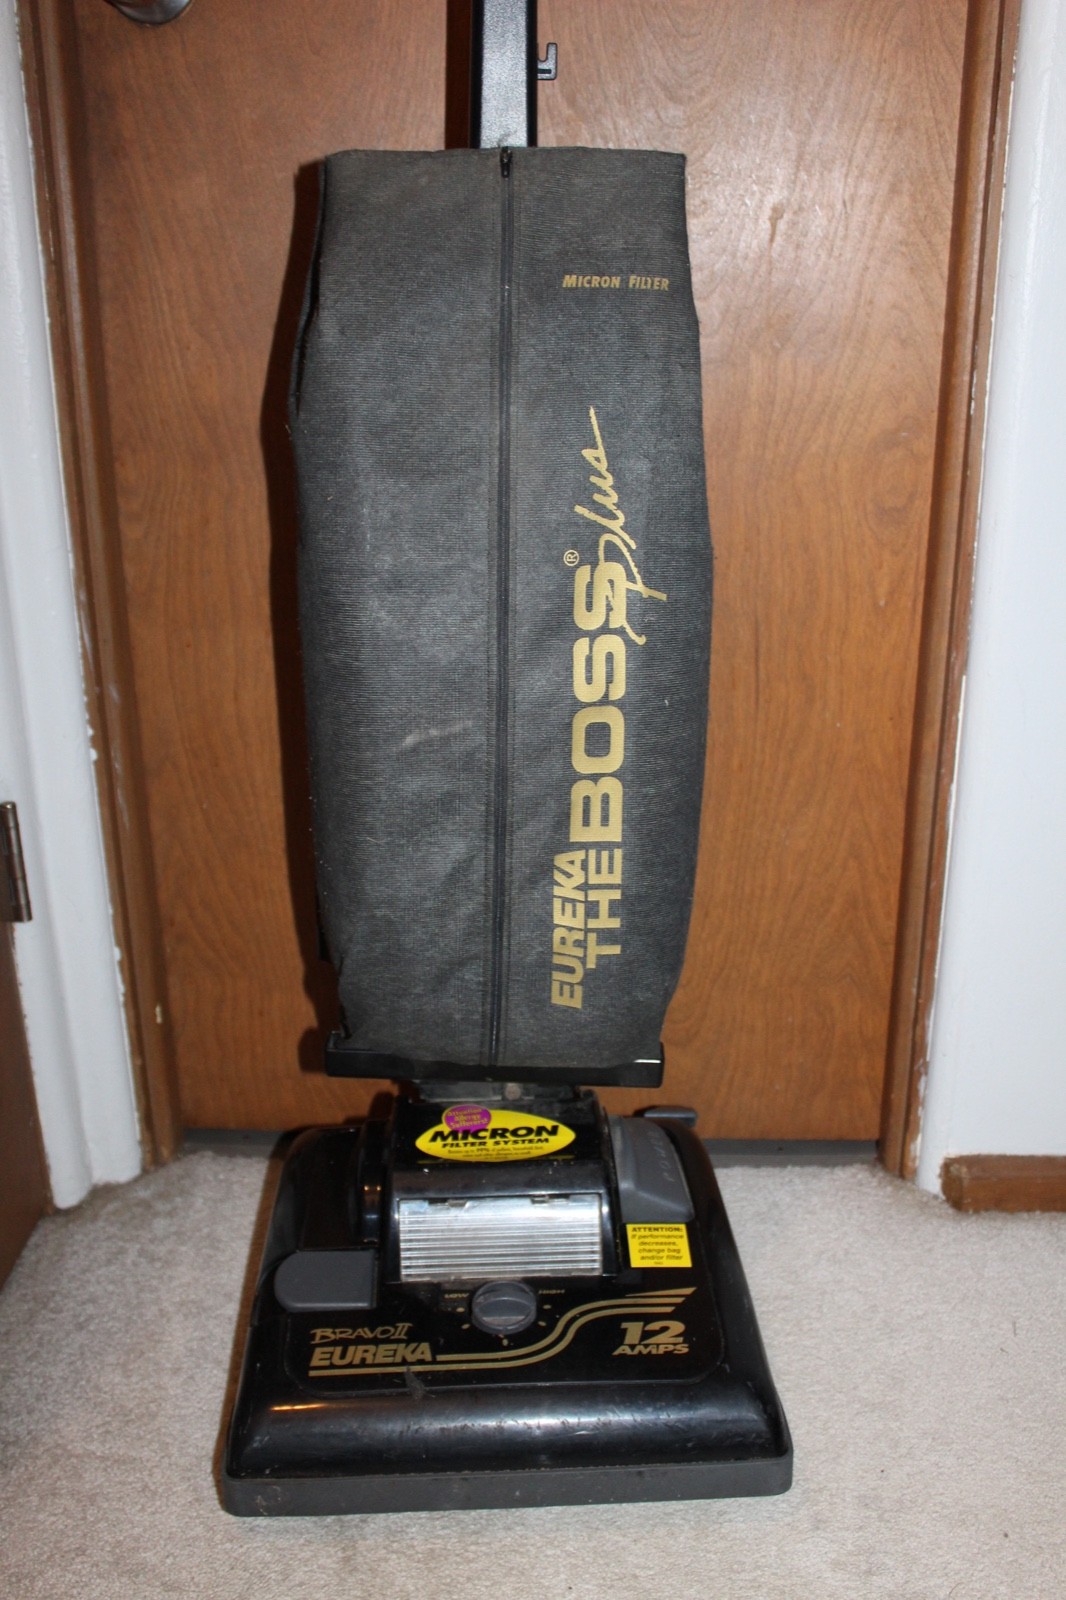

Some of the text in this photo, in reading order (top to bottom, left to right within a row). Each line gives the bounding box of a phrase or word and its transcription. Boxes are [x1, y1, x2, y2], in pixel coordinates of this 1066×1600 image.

[562, 274, 670, 291] MICRON FILTER
[574, 405, 668, 646] Plus
[570, 561, 627, 969] THE BOSS
[551, 850, 586, 1009] EUREKA
[429, 1125, 560, 1143] MICRON
[441, 1141, 488, 1149] FILTER
[492, 1137, 549, 1147] SYSTEM
[637, 1233, 684, 1241] performance
[620, 1320, 686, 1345] 12
[309, 1342, 433, 1367] EUREKA
[611, 1343, 690, 1356] AMPS
